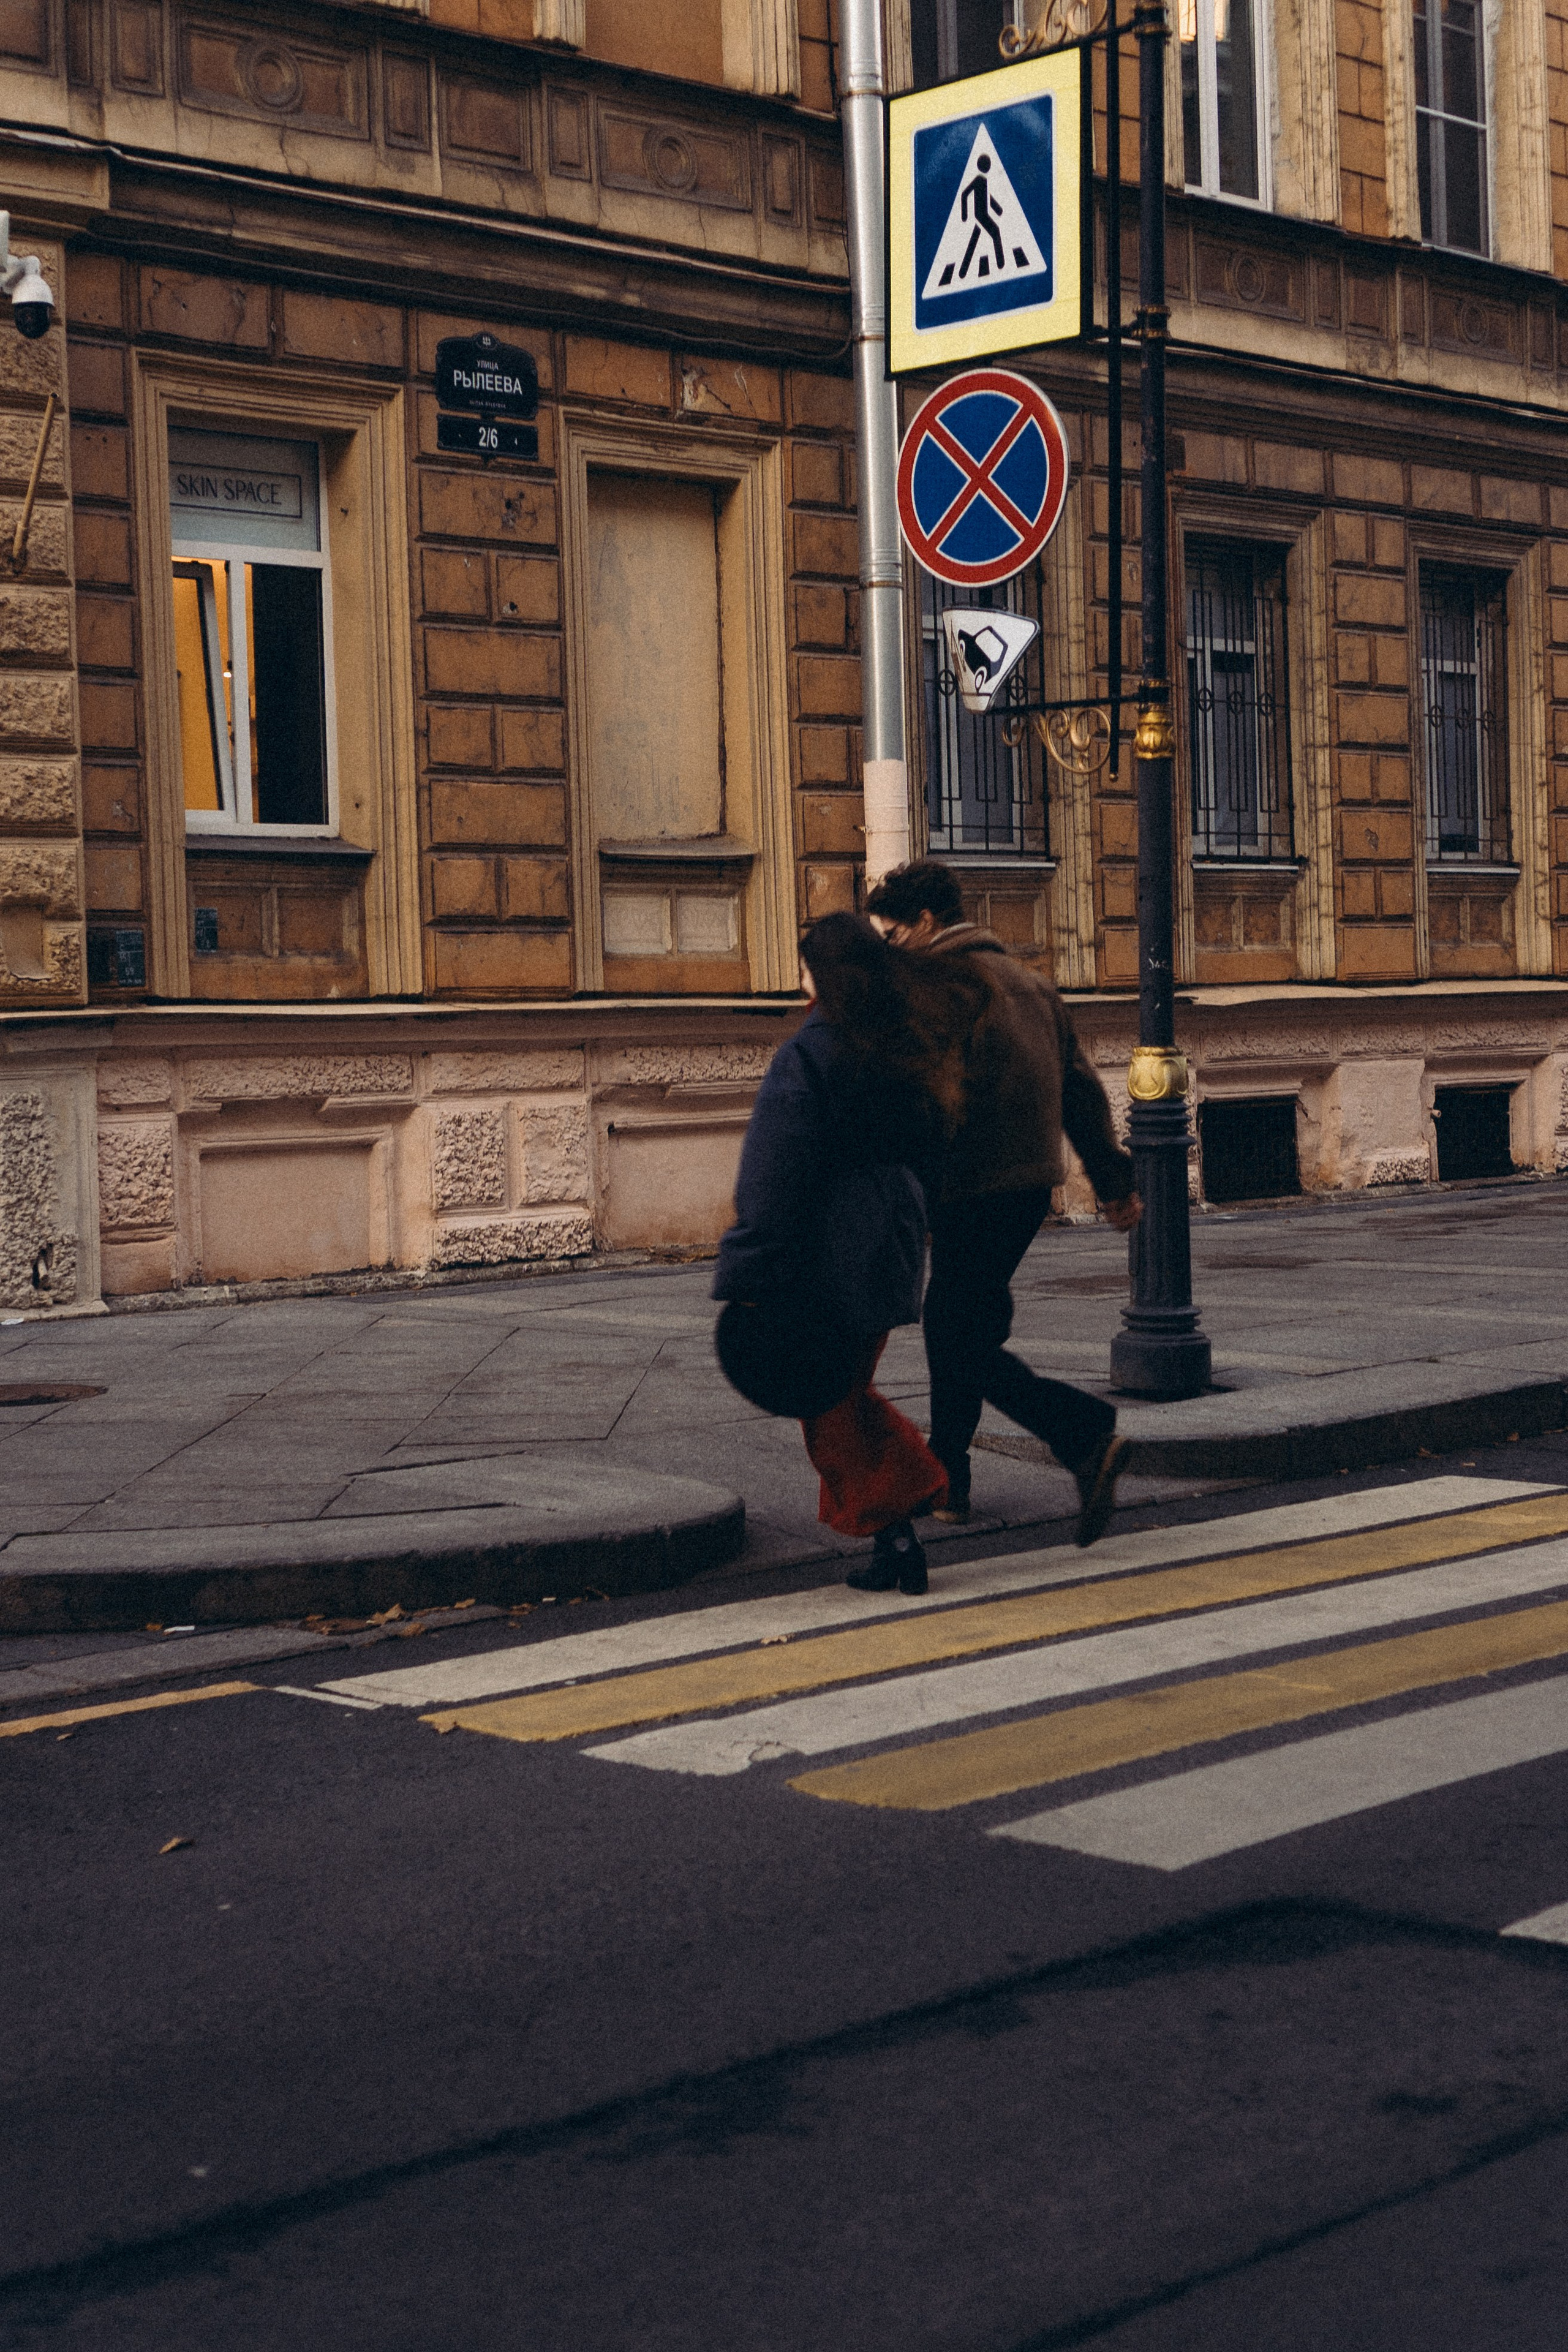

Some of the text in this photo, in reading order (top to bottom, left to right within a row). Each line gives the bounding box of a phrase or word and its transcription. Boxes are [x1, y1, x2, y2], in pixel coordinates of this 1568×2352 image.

[477, 360, 499, 371] УЛИЦА
[454, 369, 522, 394] РЫЛЕЕВА
[479, 427, 498, 448] 2/6
[178, 474, 282, 505] SKIN SPACE
